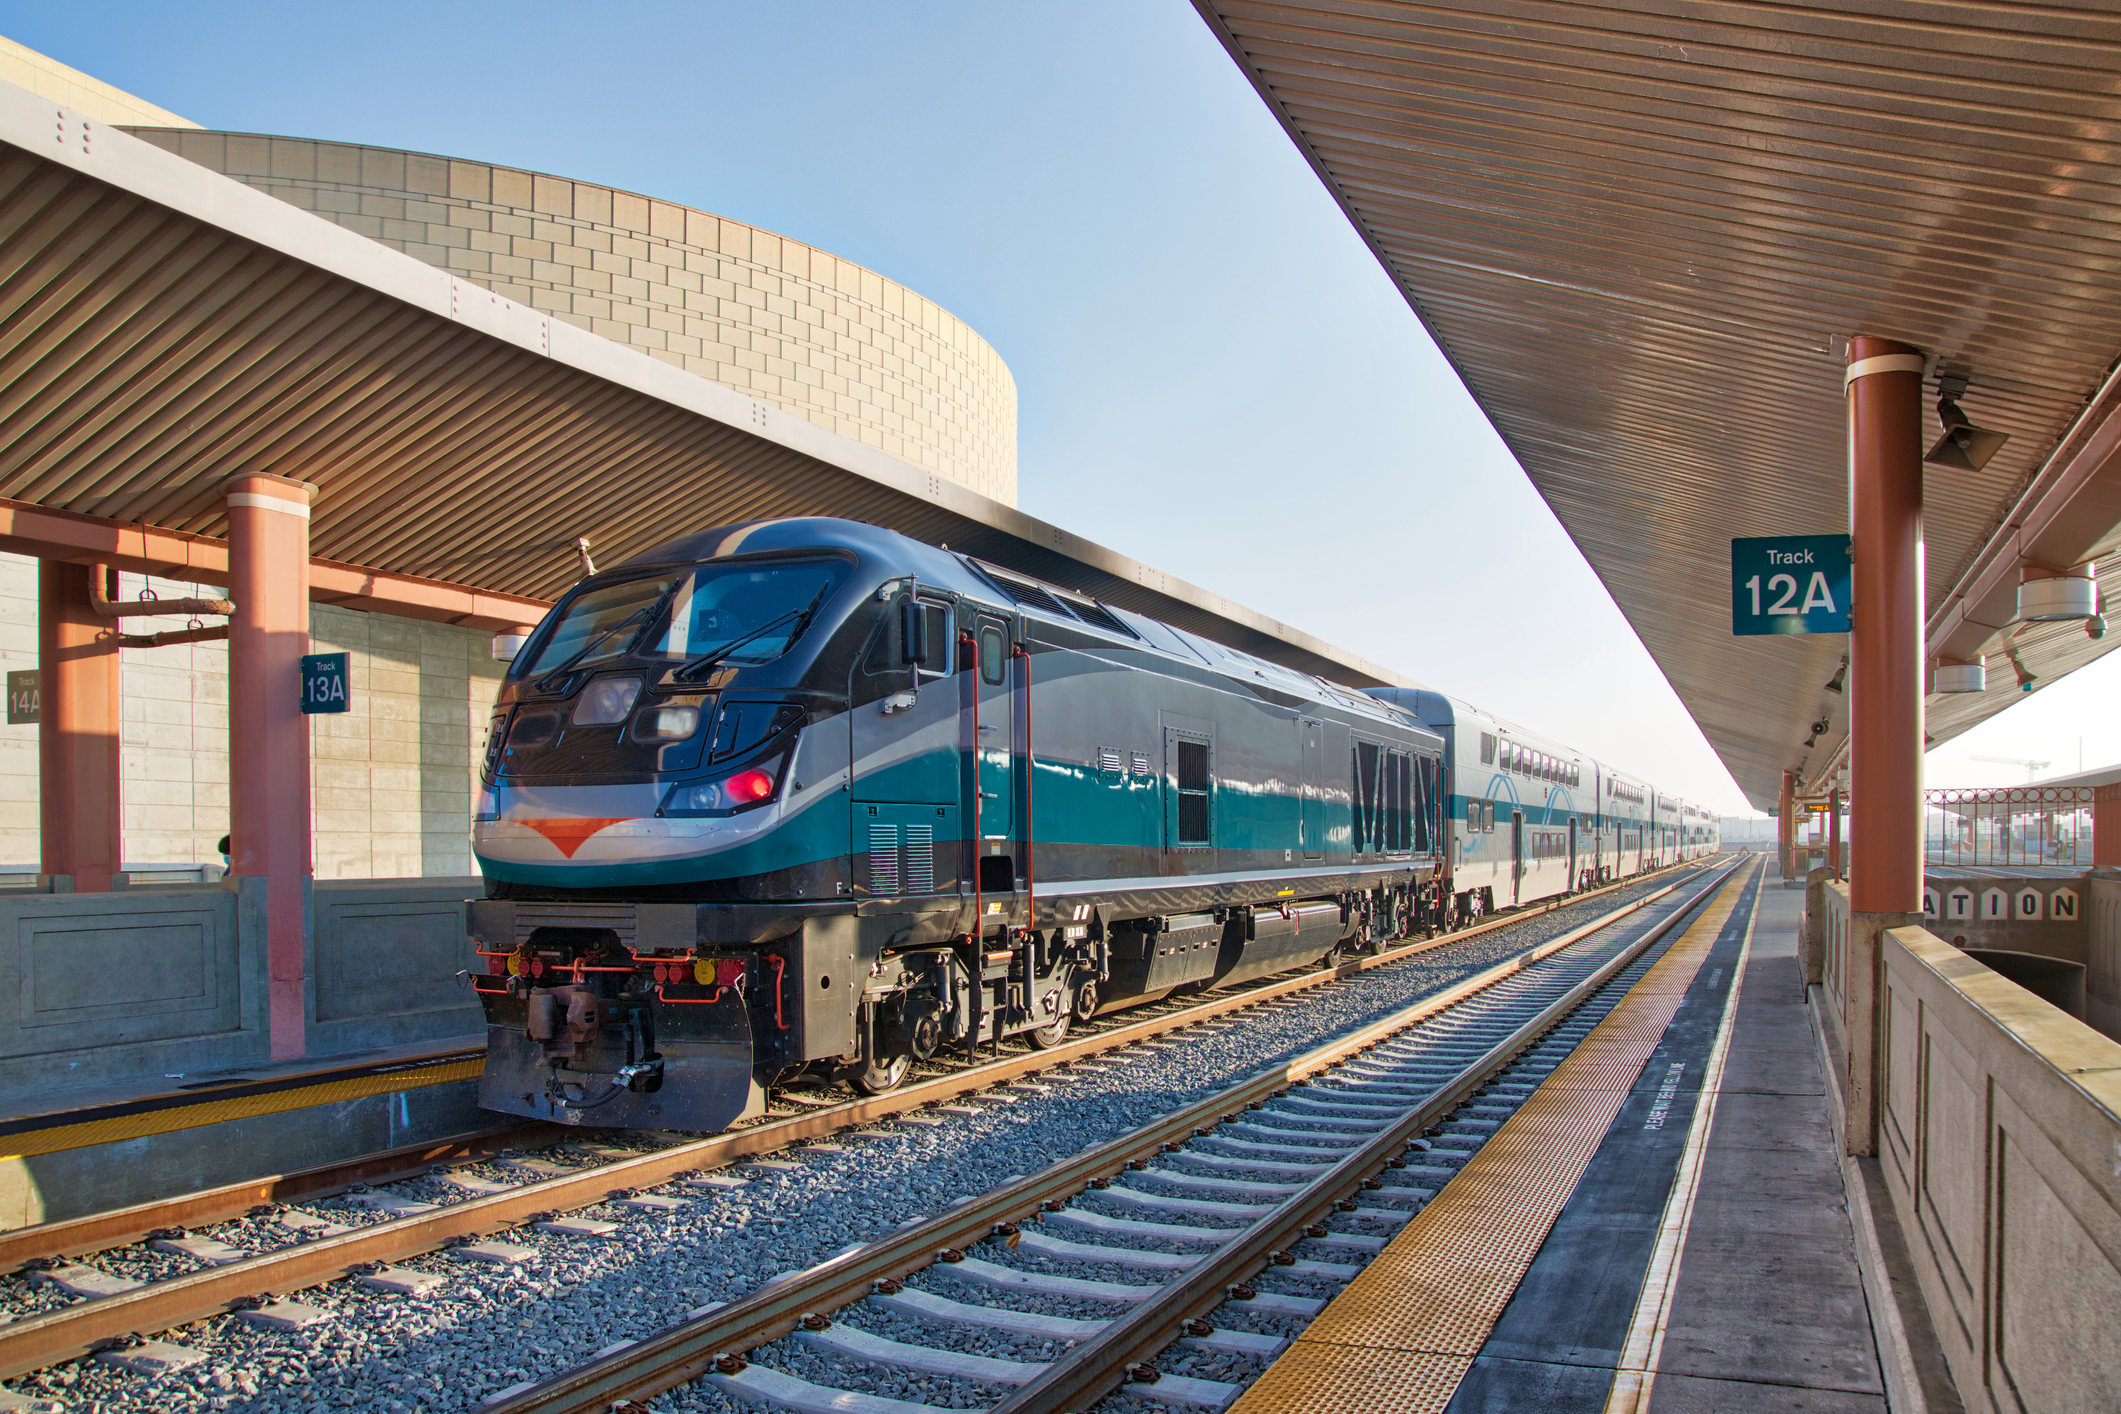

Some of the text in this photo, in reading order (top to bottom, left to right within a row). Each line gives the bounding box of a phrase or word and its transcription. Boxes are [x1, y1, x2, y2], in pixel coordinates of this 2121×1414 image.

[1767, 549, 1814, 564] Track
[1745, 571, 1837, 616] 12A
[316, 661, 336, 671] Track
[18, 677, 36, 686] Track
[307, 674, 344, 702] 13A
[836, 881, 843, 895] F
[1643, 1111, 1668, 1130] PLEASE
